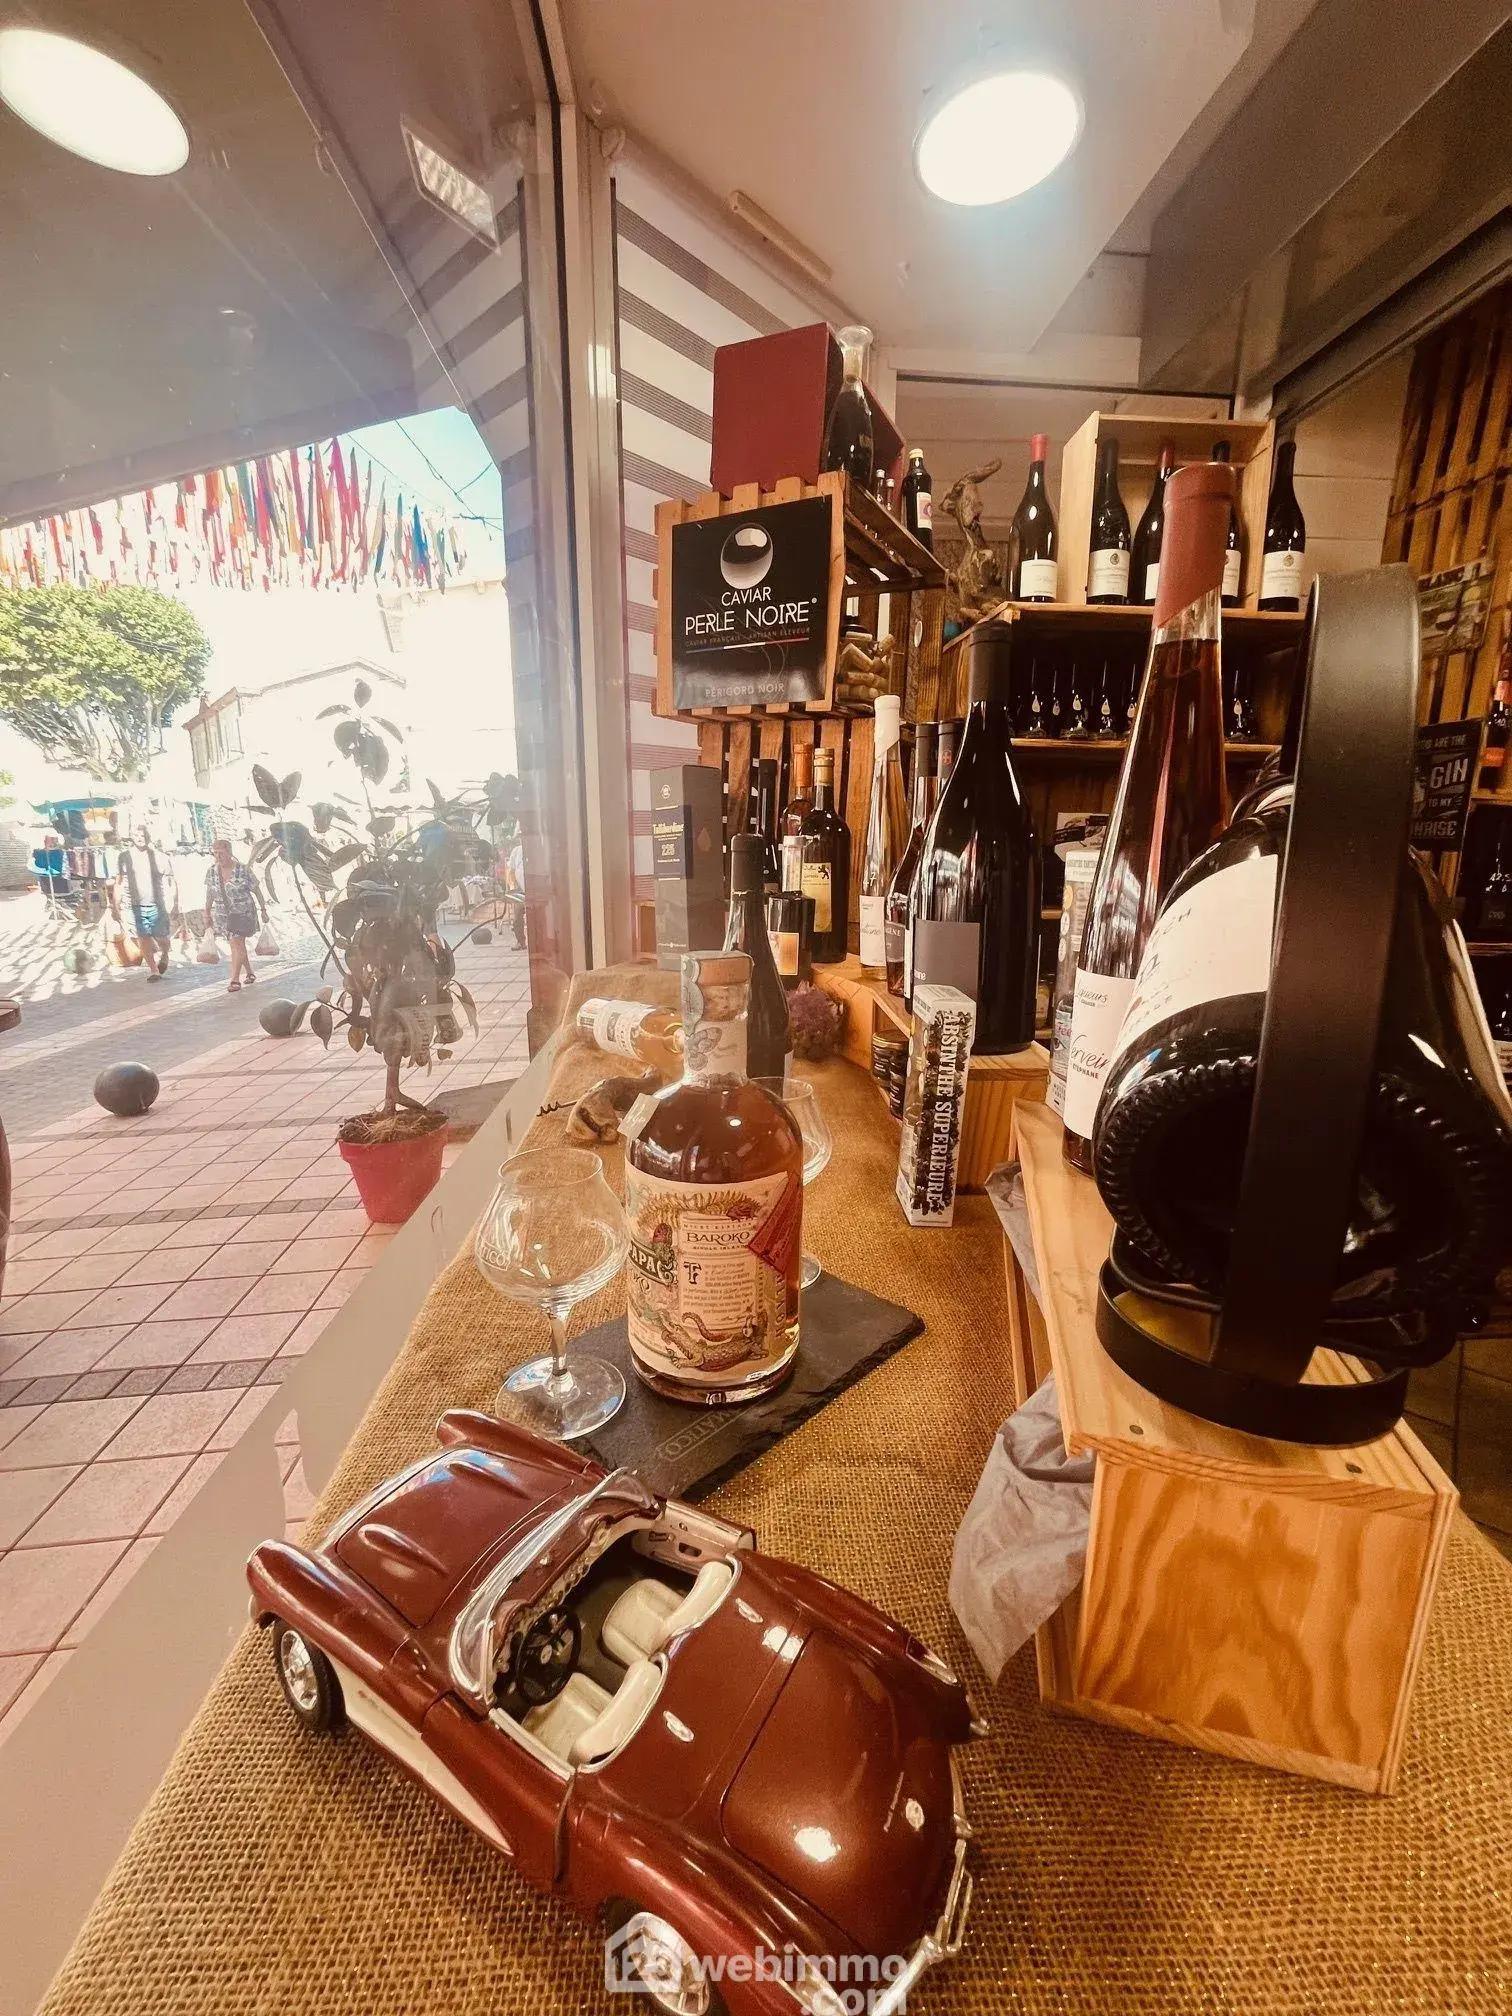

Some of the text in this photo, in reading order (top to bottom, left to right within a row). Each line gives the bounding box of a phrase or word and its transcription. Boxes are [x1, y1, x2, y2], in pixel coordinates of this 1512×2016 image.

[721, 586, 771, 606] CAVIAR
[685, 601, 810, 635] PERLE NOIRE
[758, 681, 785, 693] NOIR
[1430, 758, 1469, 788] GIN
[936, 1010, 961, 1096] ABSINTHE
[687, 1231, 750, 1246] BAROKO
